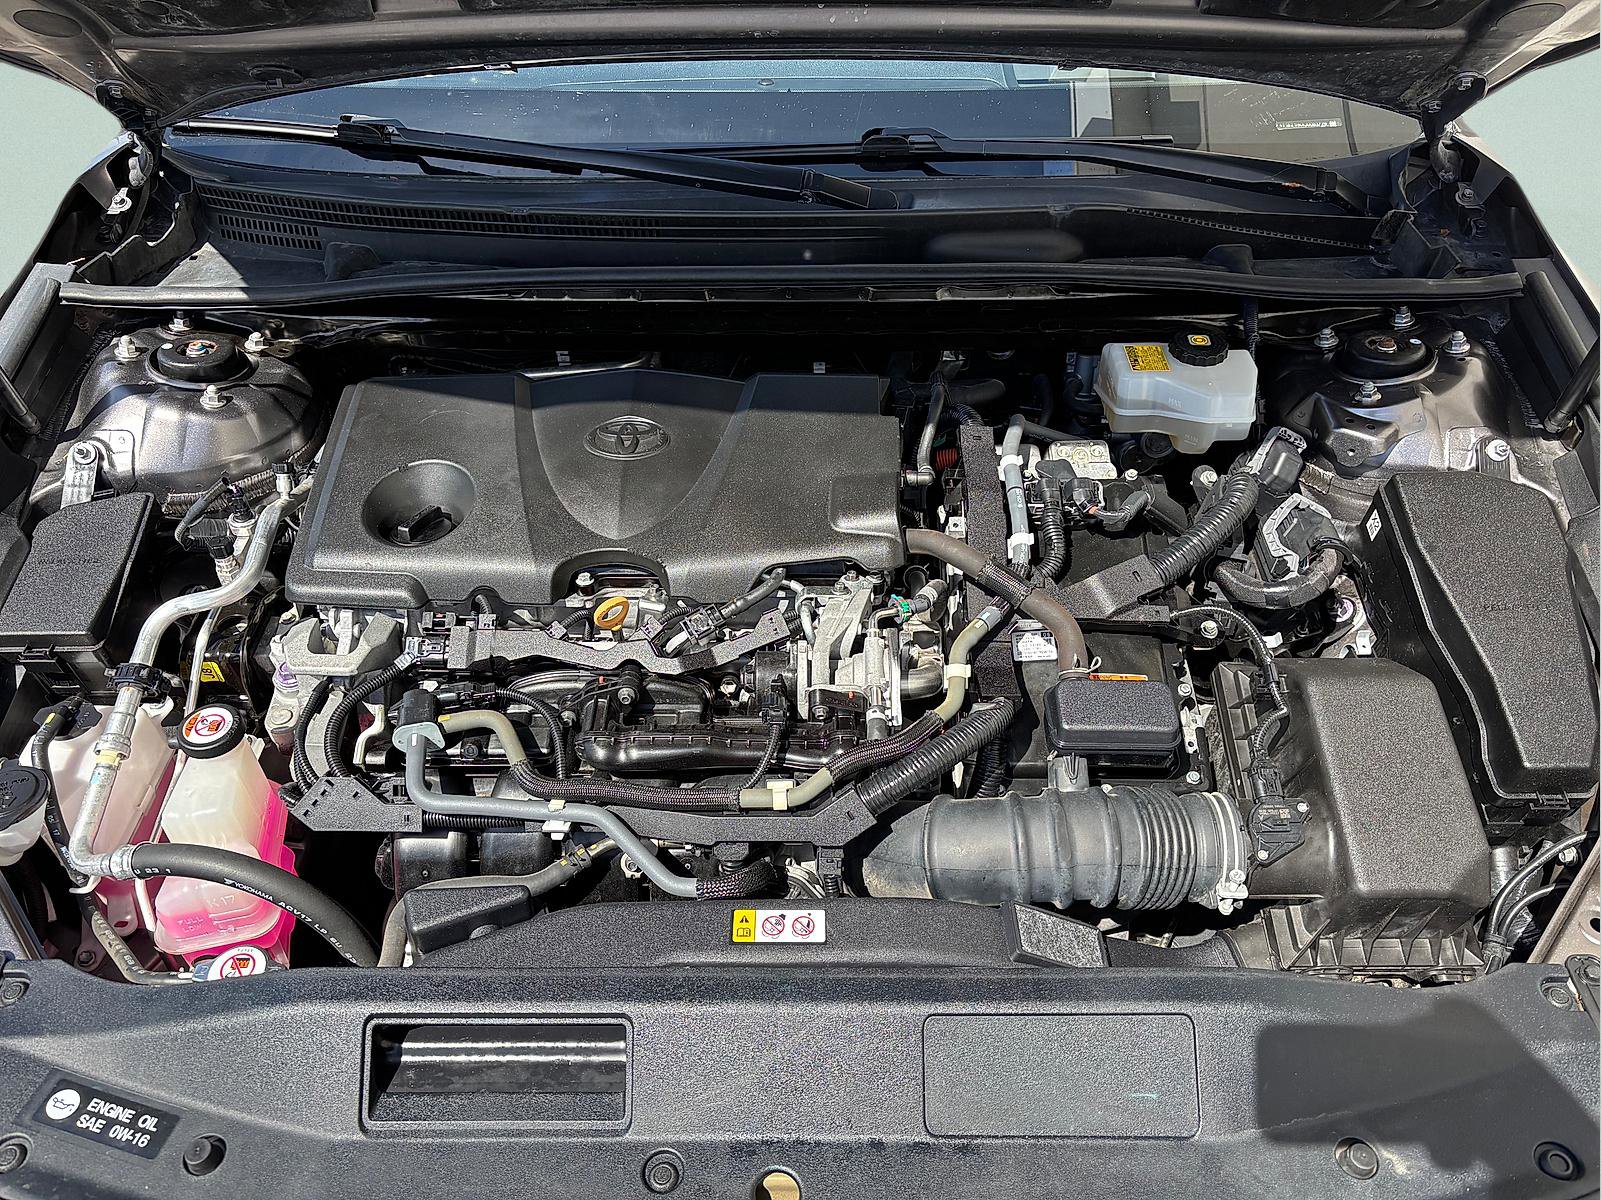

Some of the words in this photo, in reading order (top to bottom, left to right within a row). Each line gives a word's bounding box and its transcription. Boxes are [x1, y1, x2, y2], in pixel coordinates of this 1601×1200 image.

[207, 895, 235, 909] K17
[234, 881, 273, 901] YOKOHAMA
[278, 901, 313, 923] ACV17
[177, 915, 204, 926] FULL
[76, 1114, 107, 1134] SAE
[108, 1124, 151, 1148] 0W-16
[87, 1098, 136, 1123] ENGINE
[137, 1114, 159, 1132] OIL
